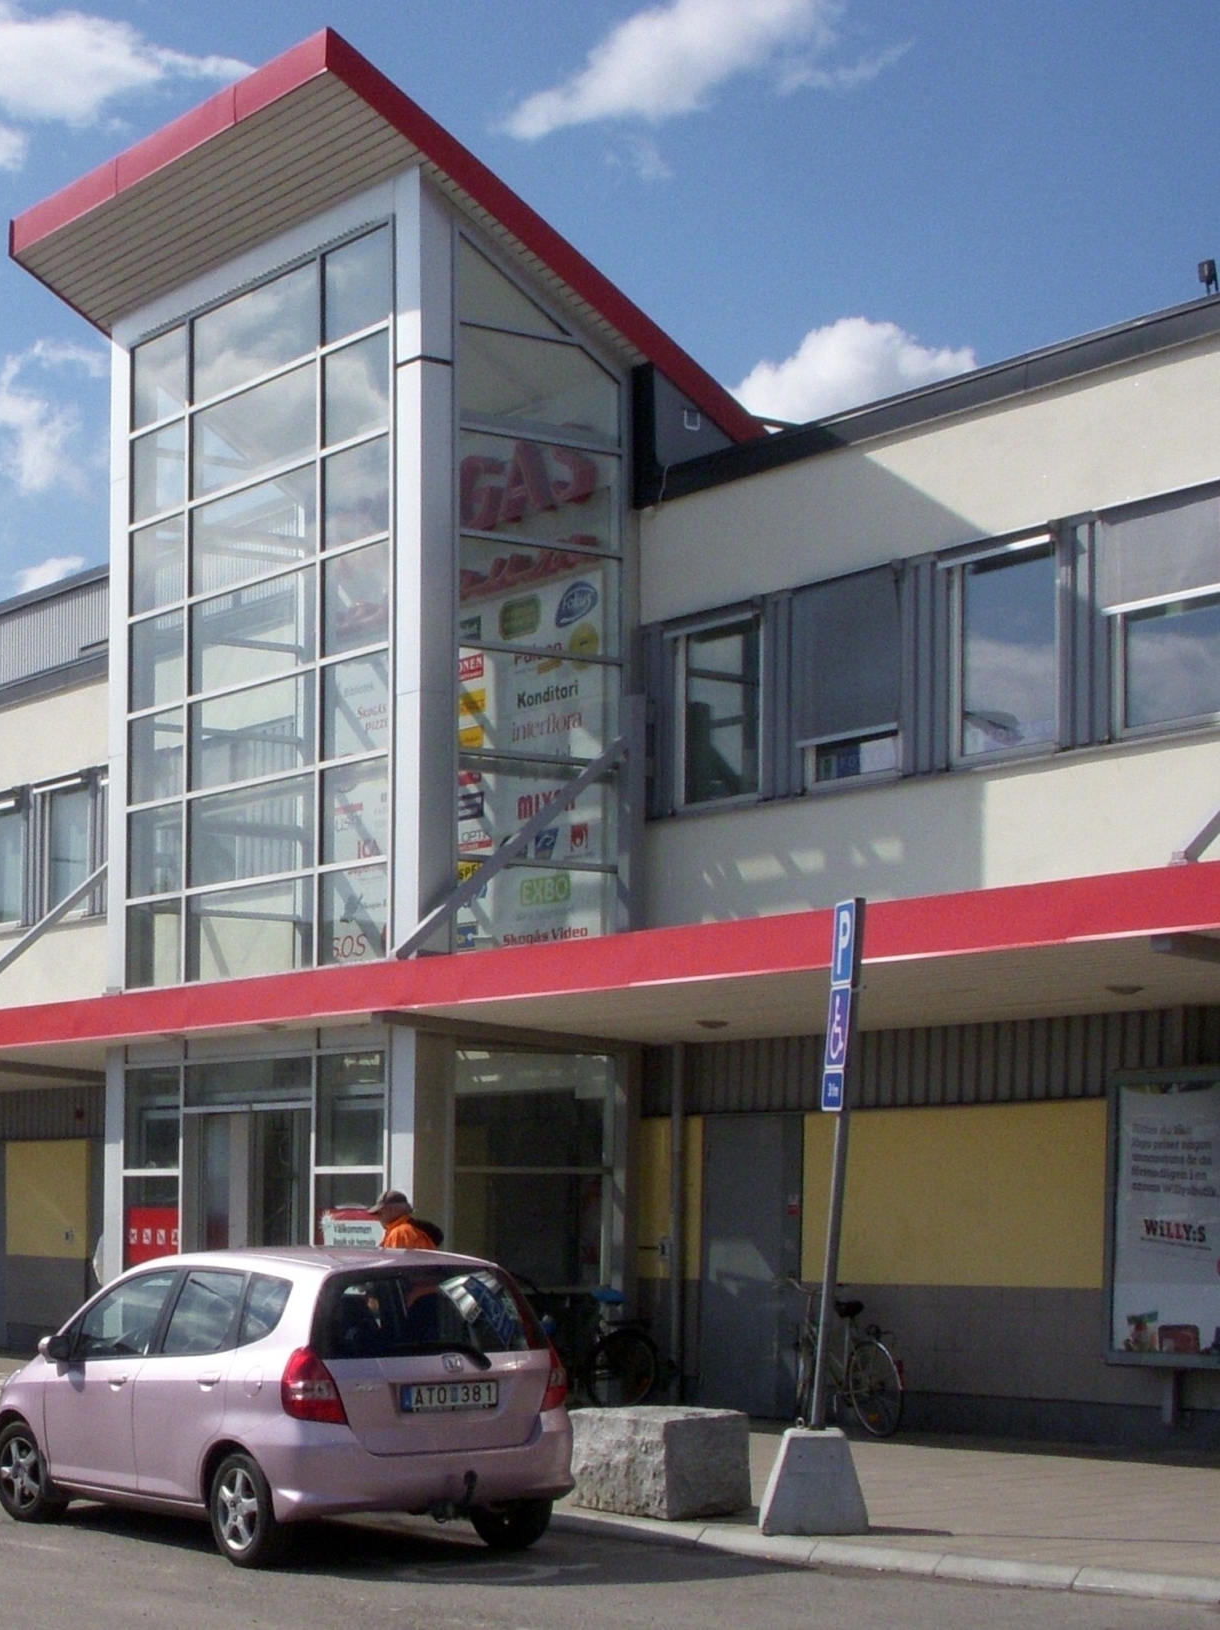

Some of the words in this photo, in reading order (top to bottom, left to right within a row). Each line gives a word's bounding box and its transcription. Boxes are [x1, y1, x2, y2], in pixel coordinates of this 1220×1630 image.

[516, 680, 579, 709] Konditori
[511, 710, 584, 742] interflora
[502, 931, 548, 946] Skogås
[551, 926, 588, 942] Video
[836, 910, 851, 975] P
[333, 1223, 372, 1234] Välkommen
[414, 1387, 448, 1406] ATO
[461, 1384, 493, 1404] 381
